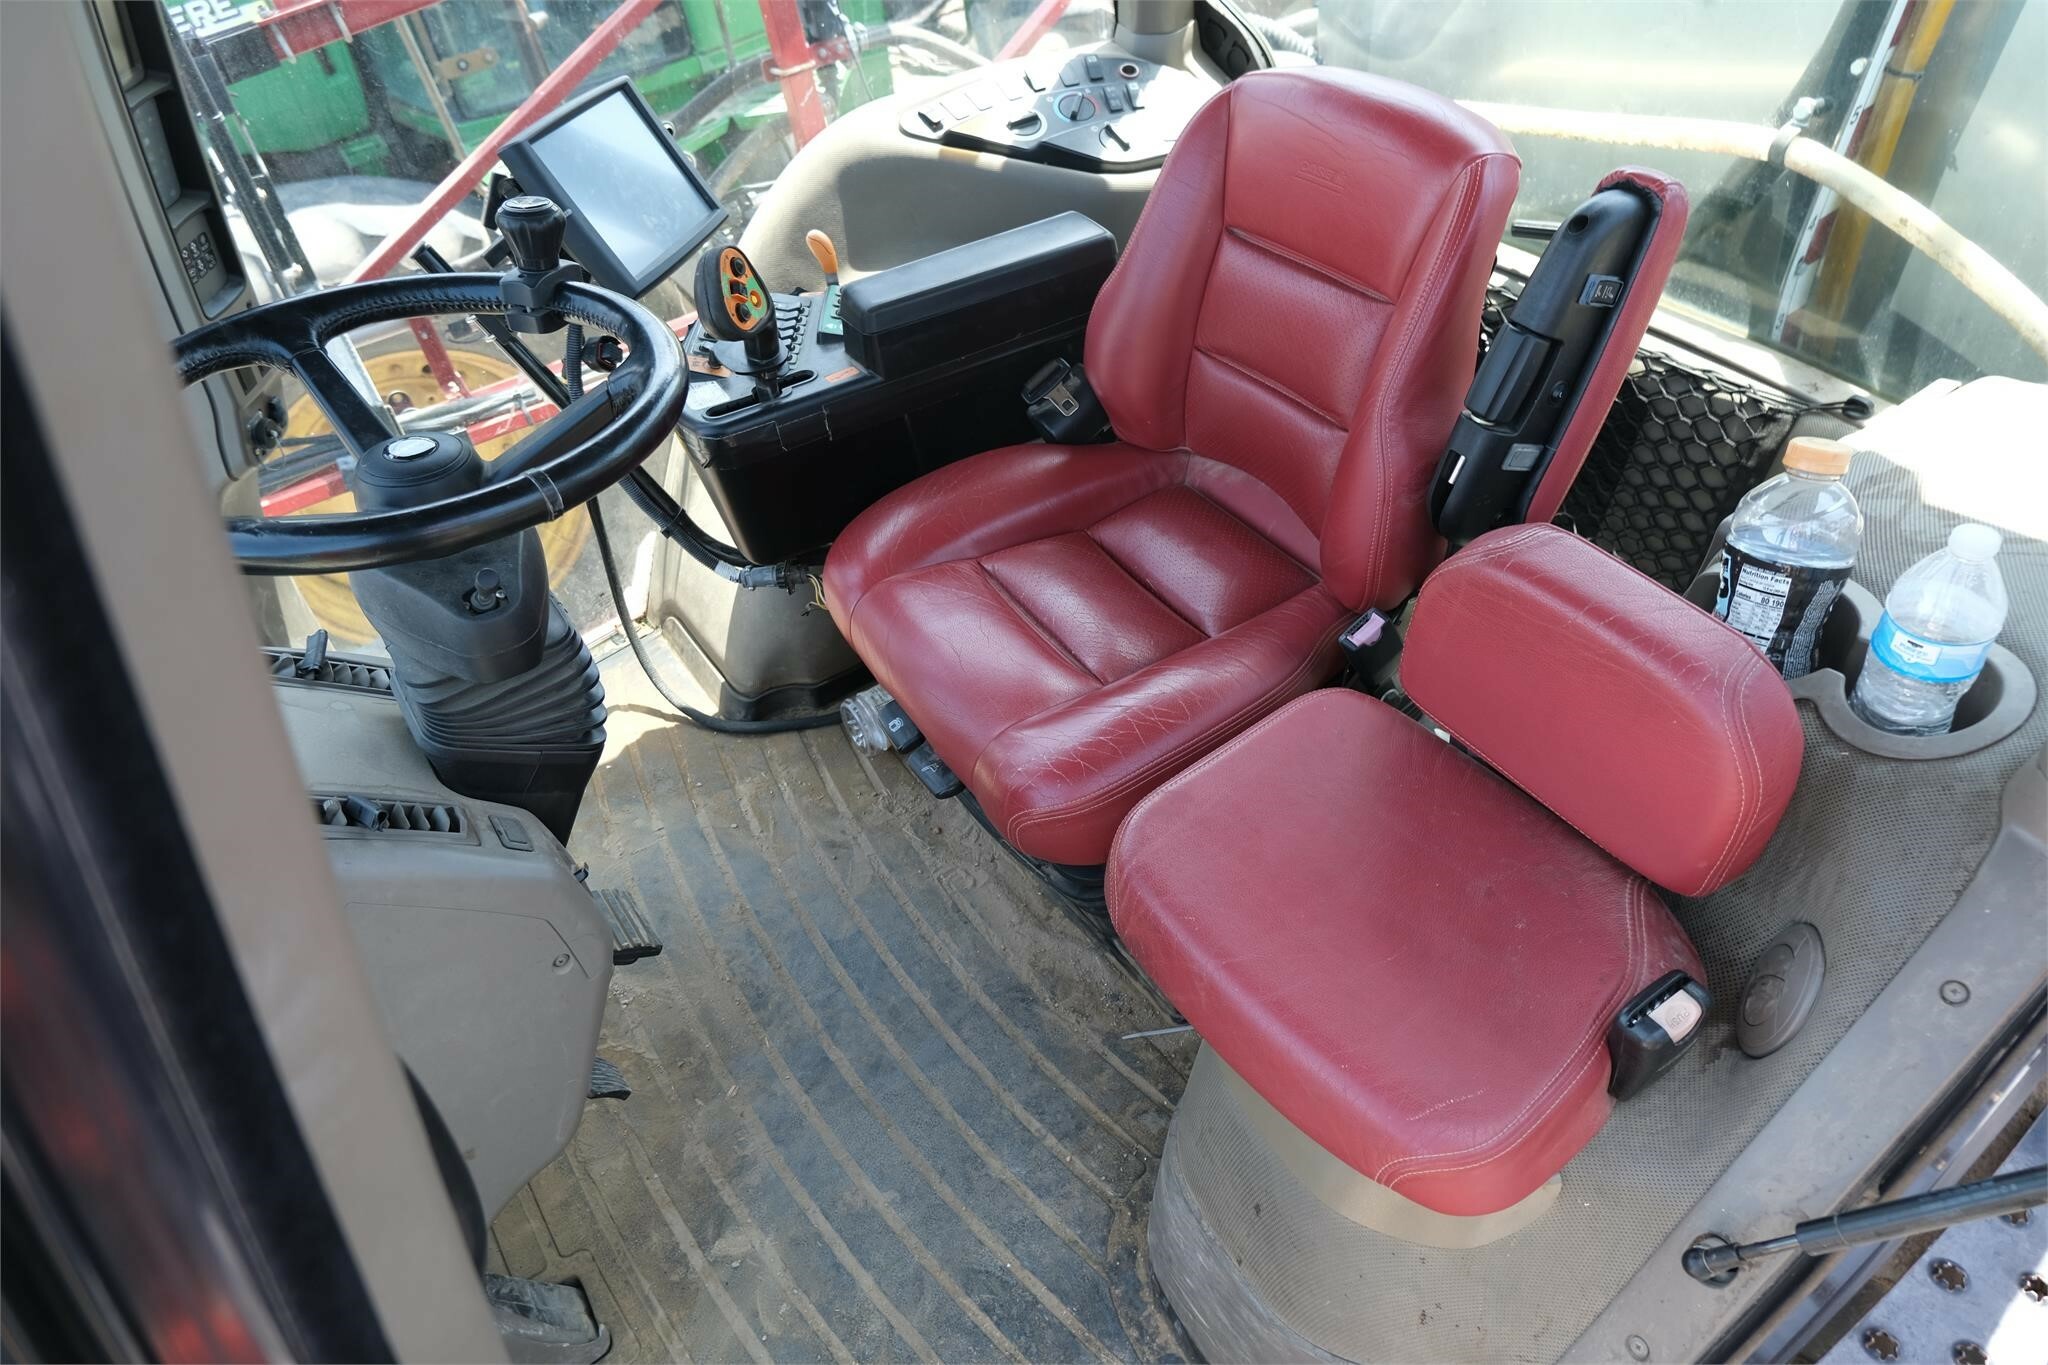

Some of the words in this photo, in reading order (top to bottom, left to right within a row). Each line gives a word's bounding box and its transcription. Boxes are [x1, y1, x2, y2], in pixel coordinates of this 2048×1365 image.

[1742, 568, 1769, 580] Nutrition
[1770, 576, 1790, 585] Facts
[1760, 597, 1770, 605] 80
[1772, 599, 1785, 608] 190
